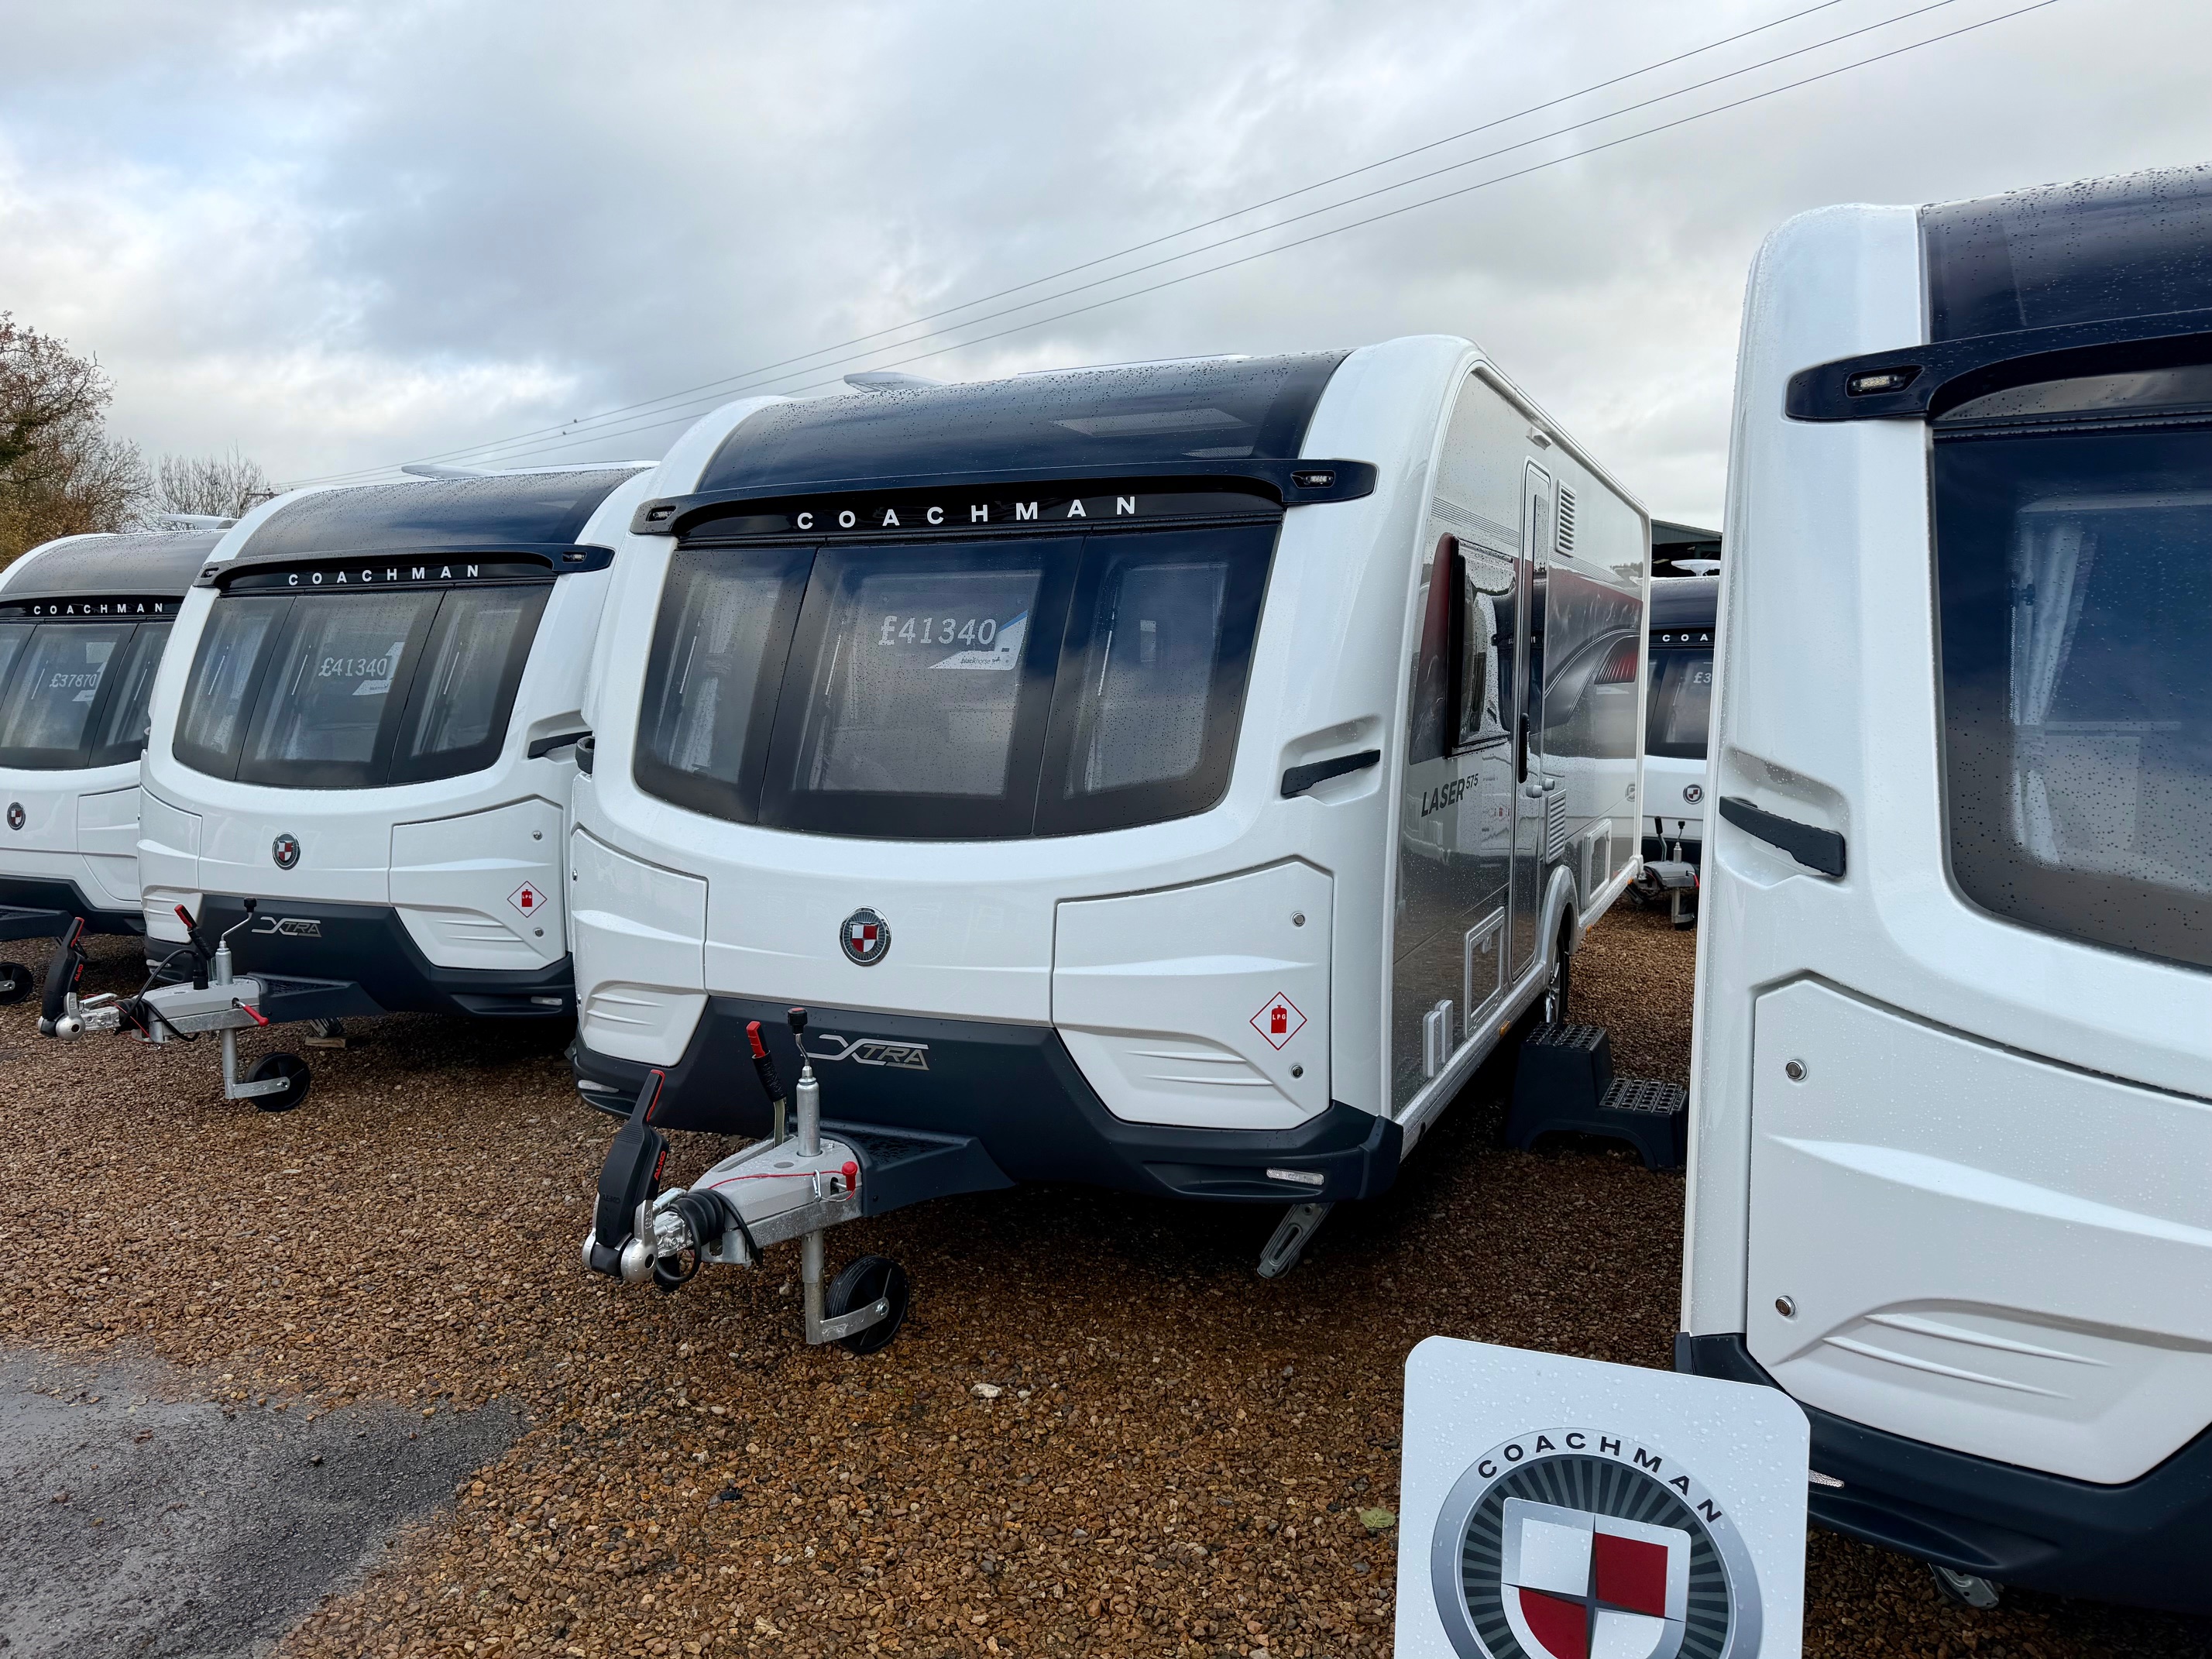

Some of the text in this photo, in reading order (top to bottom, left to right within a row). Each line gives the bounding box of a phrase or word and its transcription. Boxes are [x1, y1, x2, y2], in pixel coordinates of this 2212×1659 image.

[797, 496, 1135, 531] COACHMAN
[288, 565, 479, 586] COACHMAN
[33, 603, 163, 615] COACHMAN
[878, 615, 997, 646] £41340
[318, 657, 387, 677] £41340
[49, 673, 97, 688] £37870
[1420, 773, 1479, 817] LASER 575
[1478, 1433, 1723, 1523] COACHMAN
